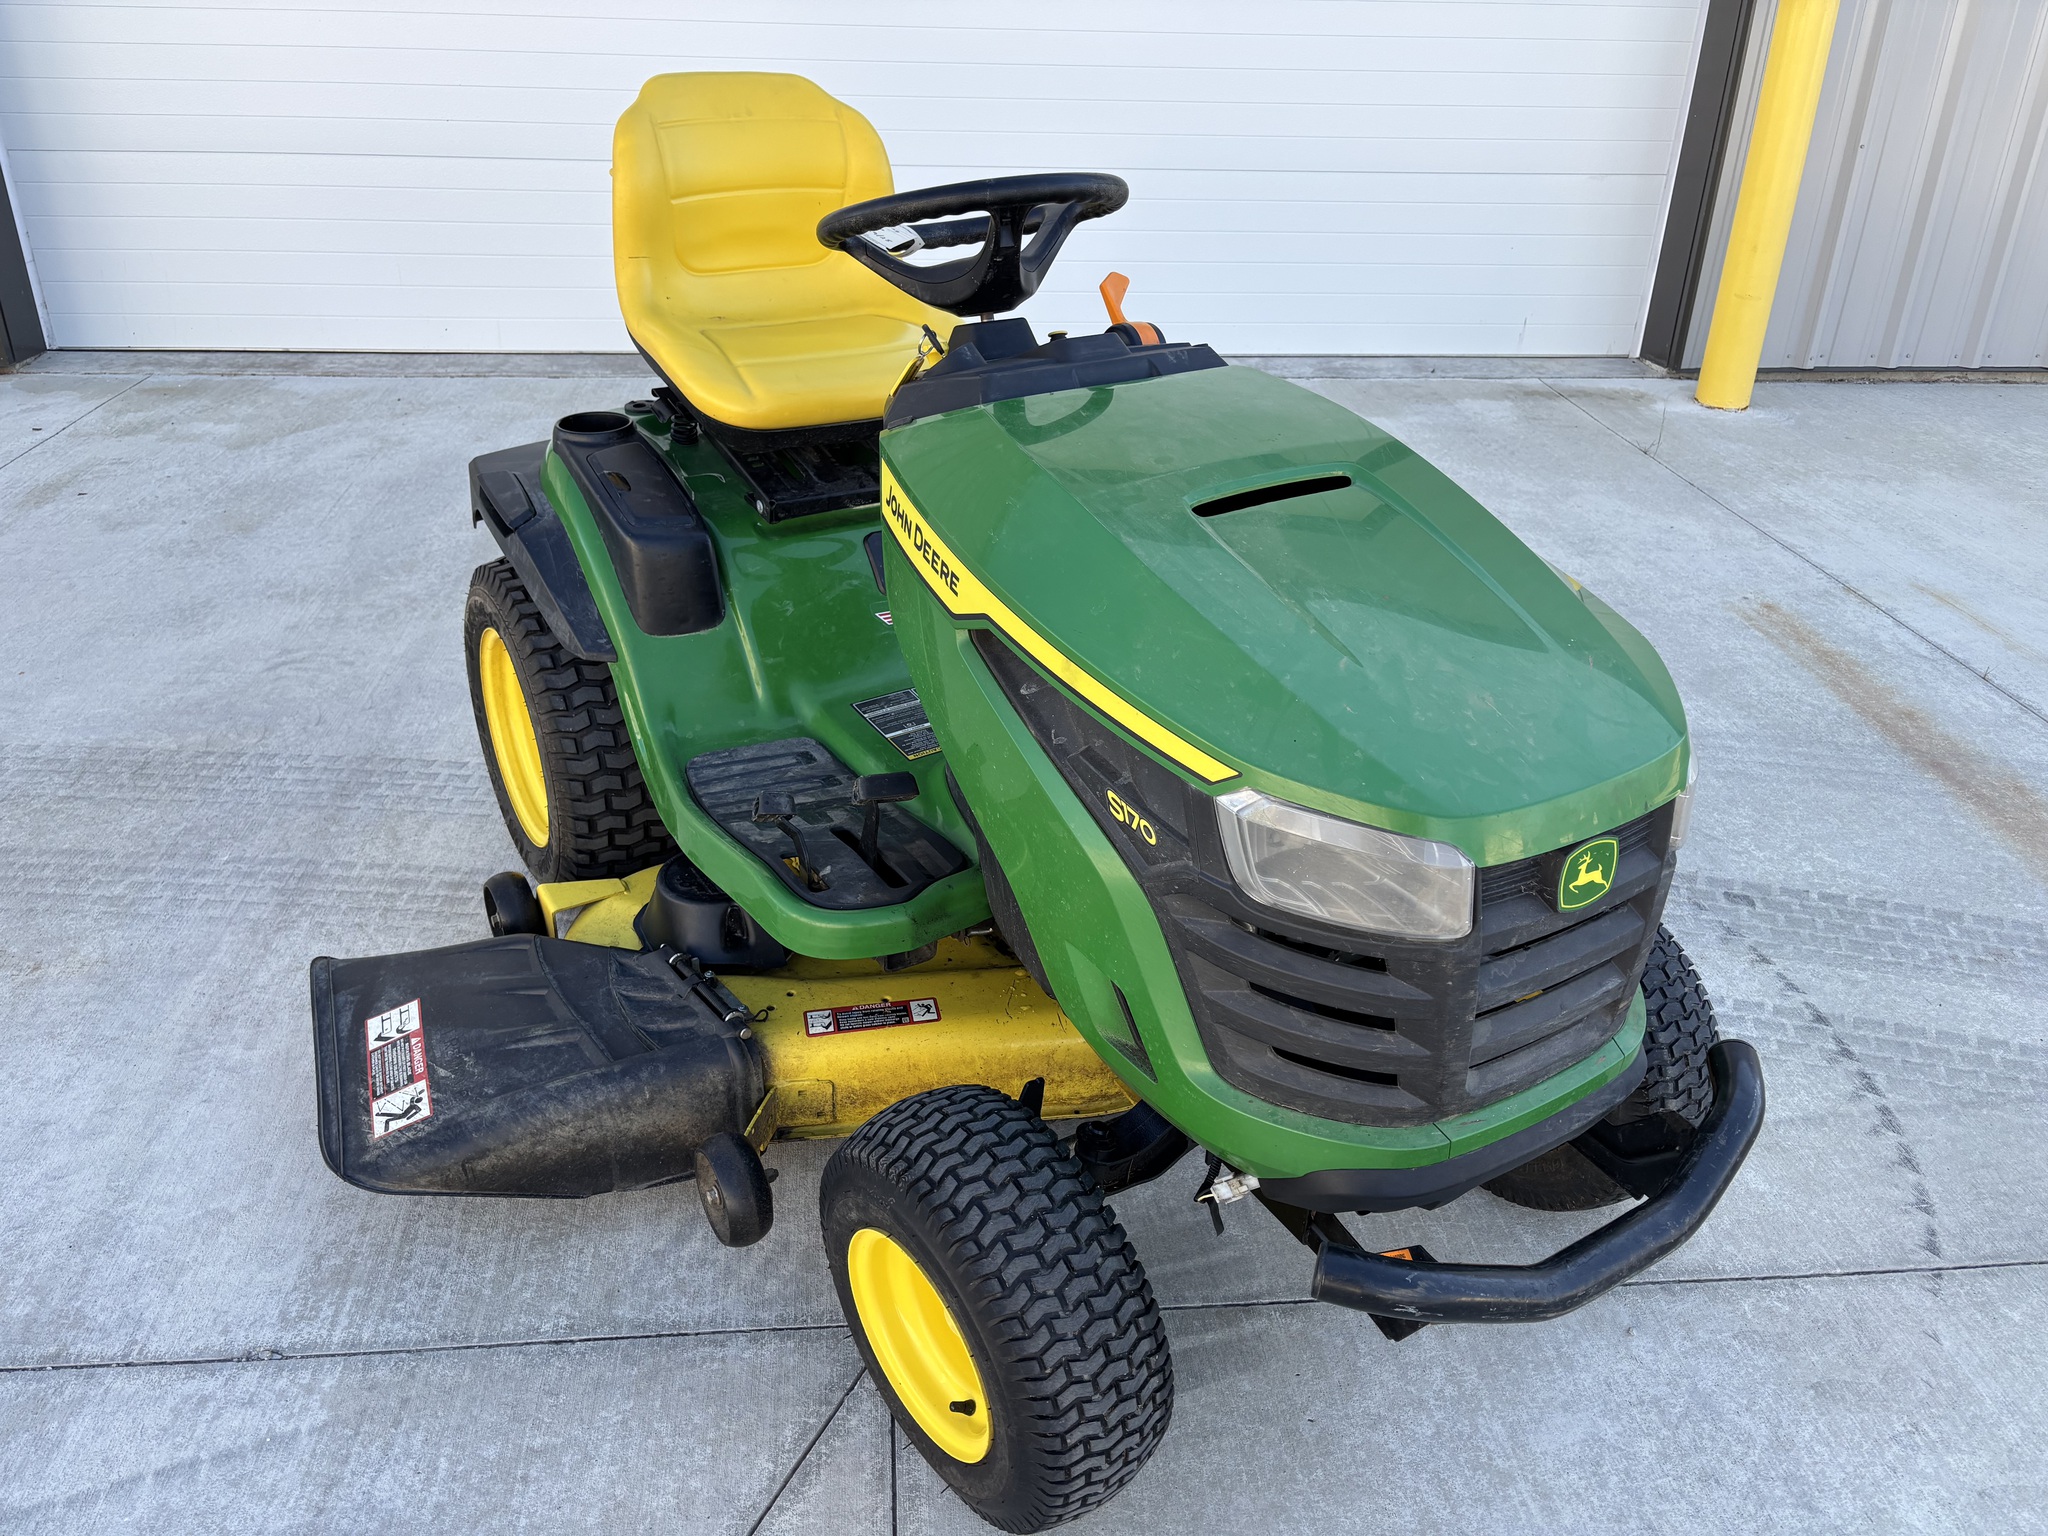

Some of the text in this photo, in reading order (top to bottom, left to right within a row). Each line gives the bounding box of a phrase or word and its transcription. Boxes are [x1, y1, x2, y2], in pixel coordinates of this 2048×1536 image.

[886, 485, 960, 597] JOHN DEERE
[1106, 789, 1157, 846] S170
[859, 1002, 891, 1010] DANGER
[412, 1042, 425, 1075] DANGER
